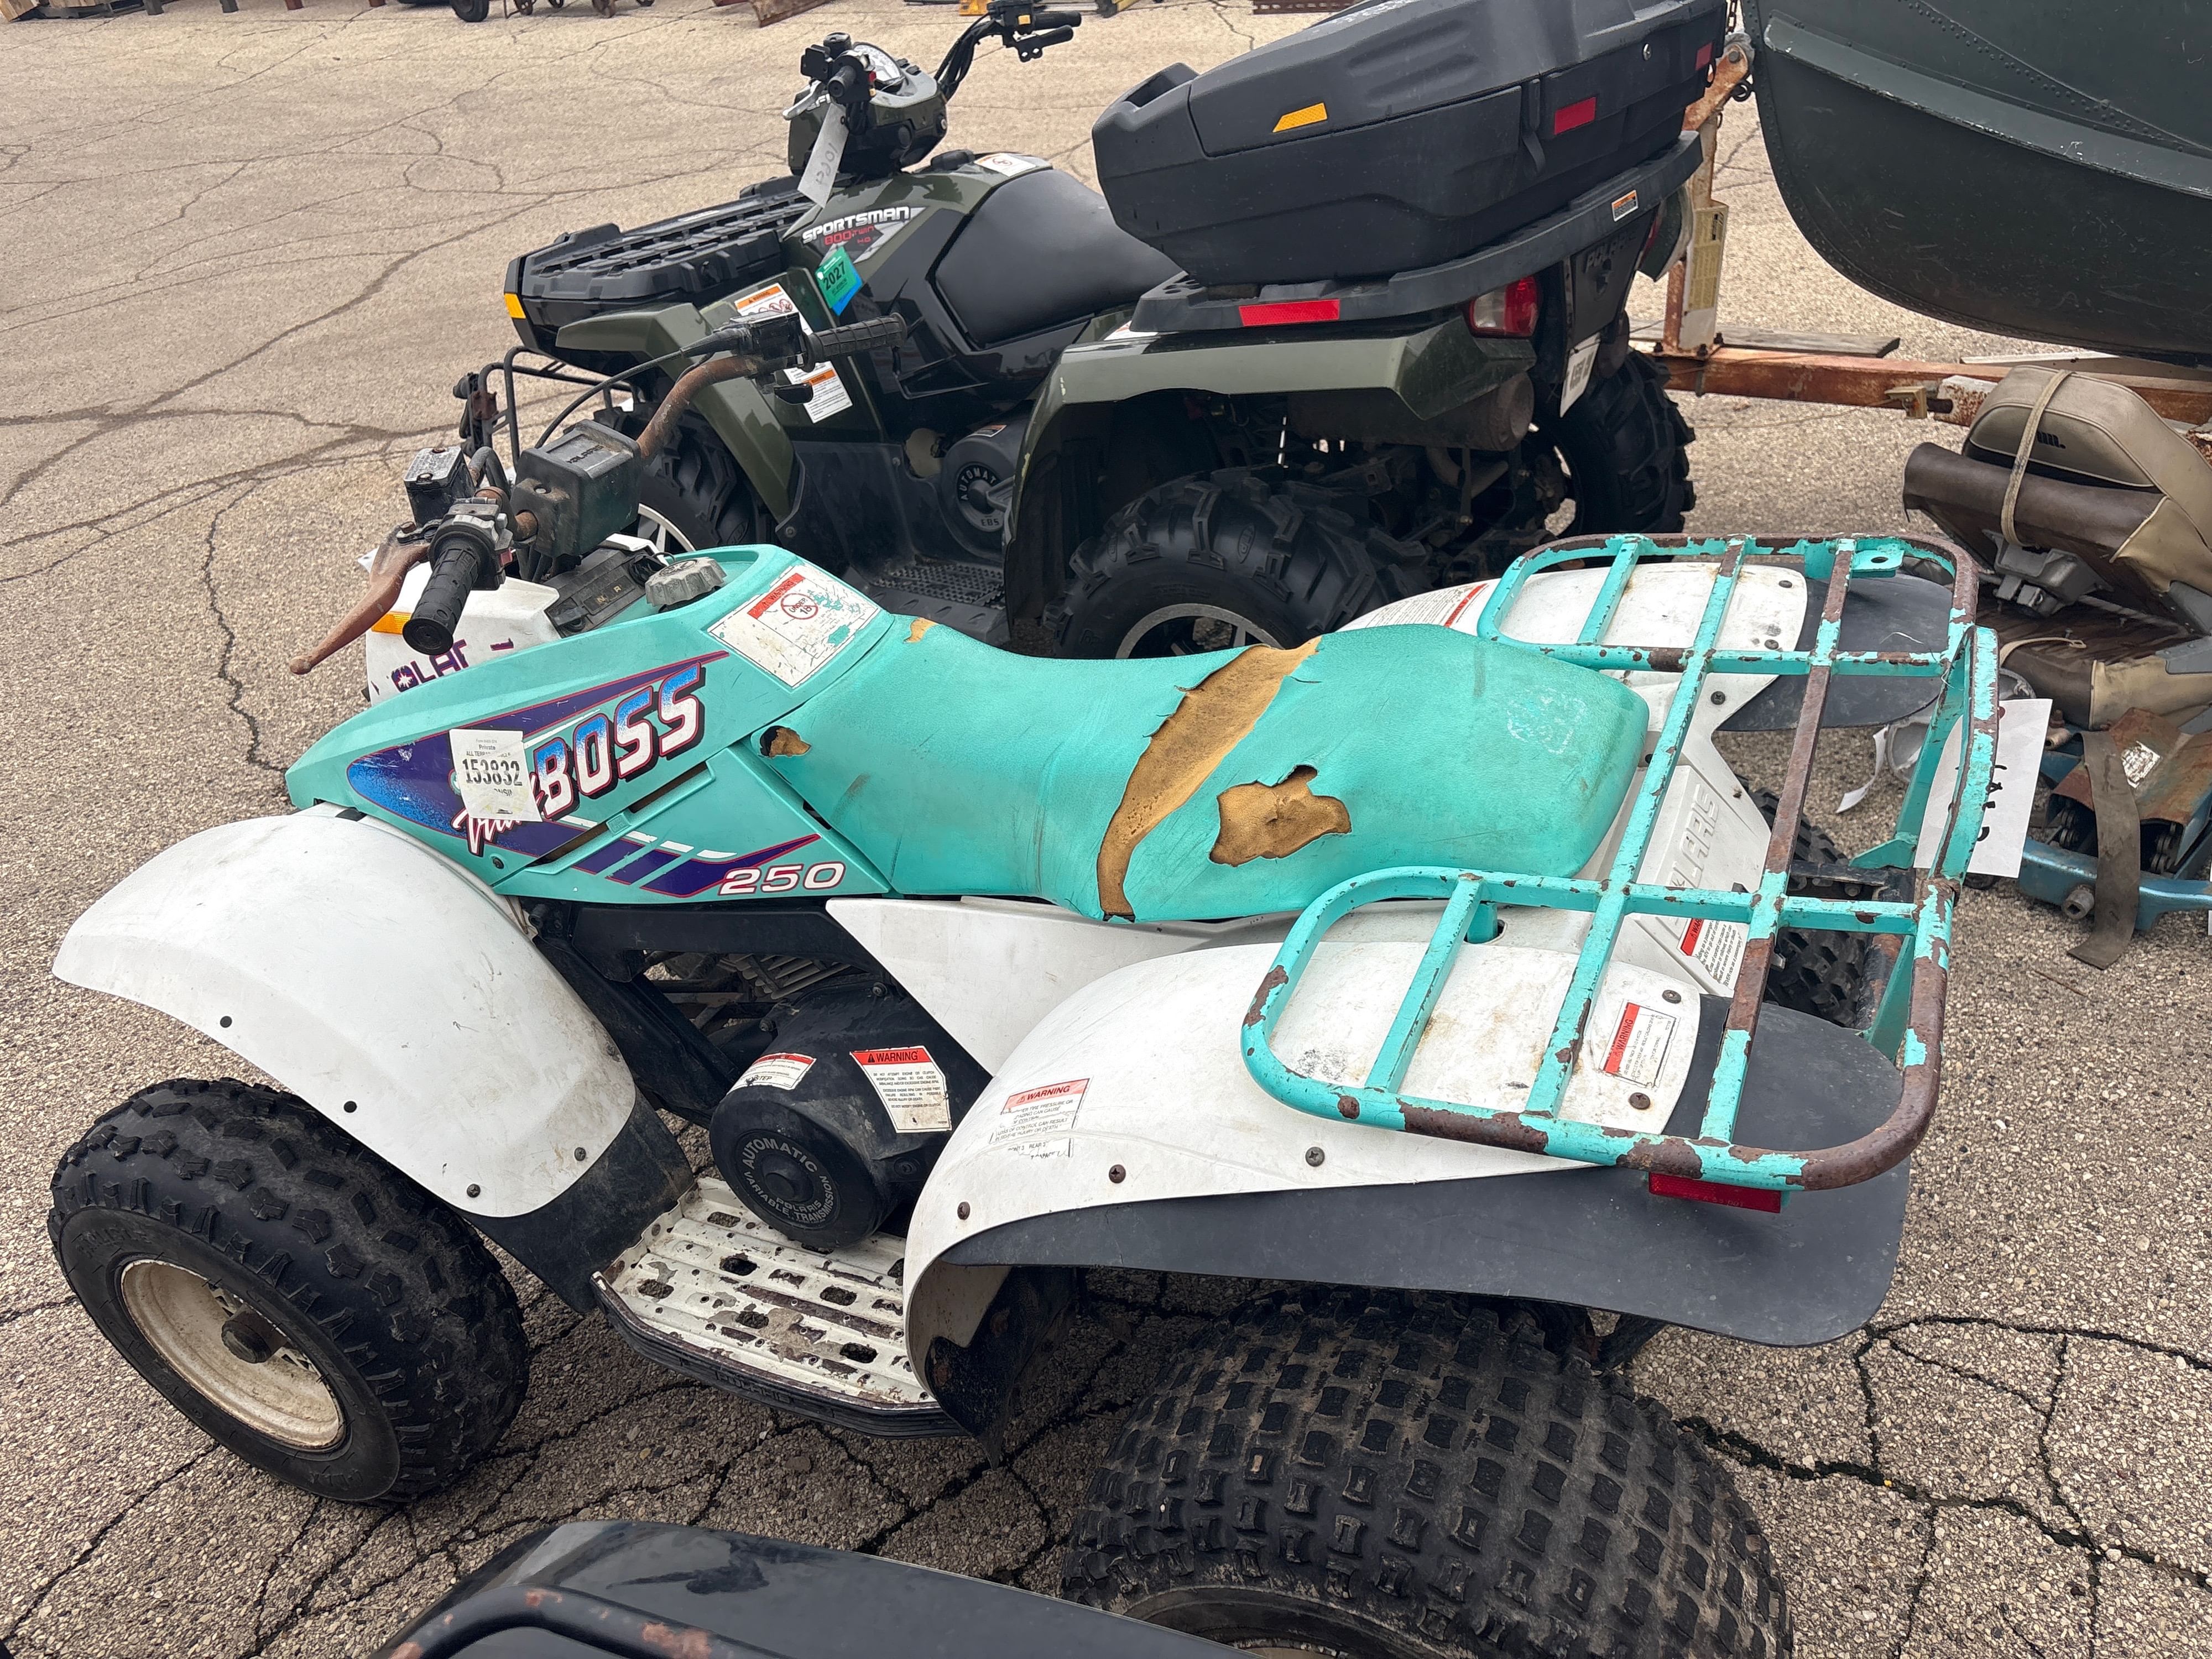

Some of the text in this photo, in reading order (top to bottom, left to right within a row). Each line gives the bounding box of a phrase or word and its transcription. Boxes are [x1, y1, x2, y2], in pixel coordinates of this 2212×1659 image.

[802, 206, 910, 244] SPORTSMAN
[823, 262, 846, 291] 2027
[959, 468, 997, 501] AUTOMAT
[533, 661, 706, 821] BOSS
[462, 759, 523, 786] 153832
[718, 861, 846, 896] 250
[1616, 1019, 1634, 1053] WARNING
[876, 1051, 918, 1062] WARNING
[1027, 1086, 1071, 1100] WARNING
[742, 1138, 817, 1172] AUTOMATIC
[744, 1171, 790, 1216] VARIABLE
[776, 1197, 822, 1213] POLARIS
[794, 1176, 833, 1222] TRANSMISSION
